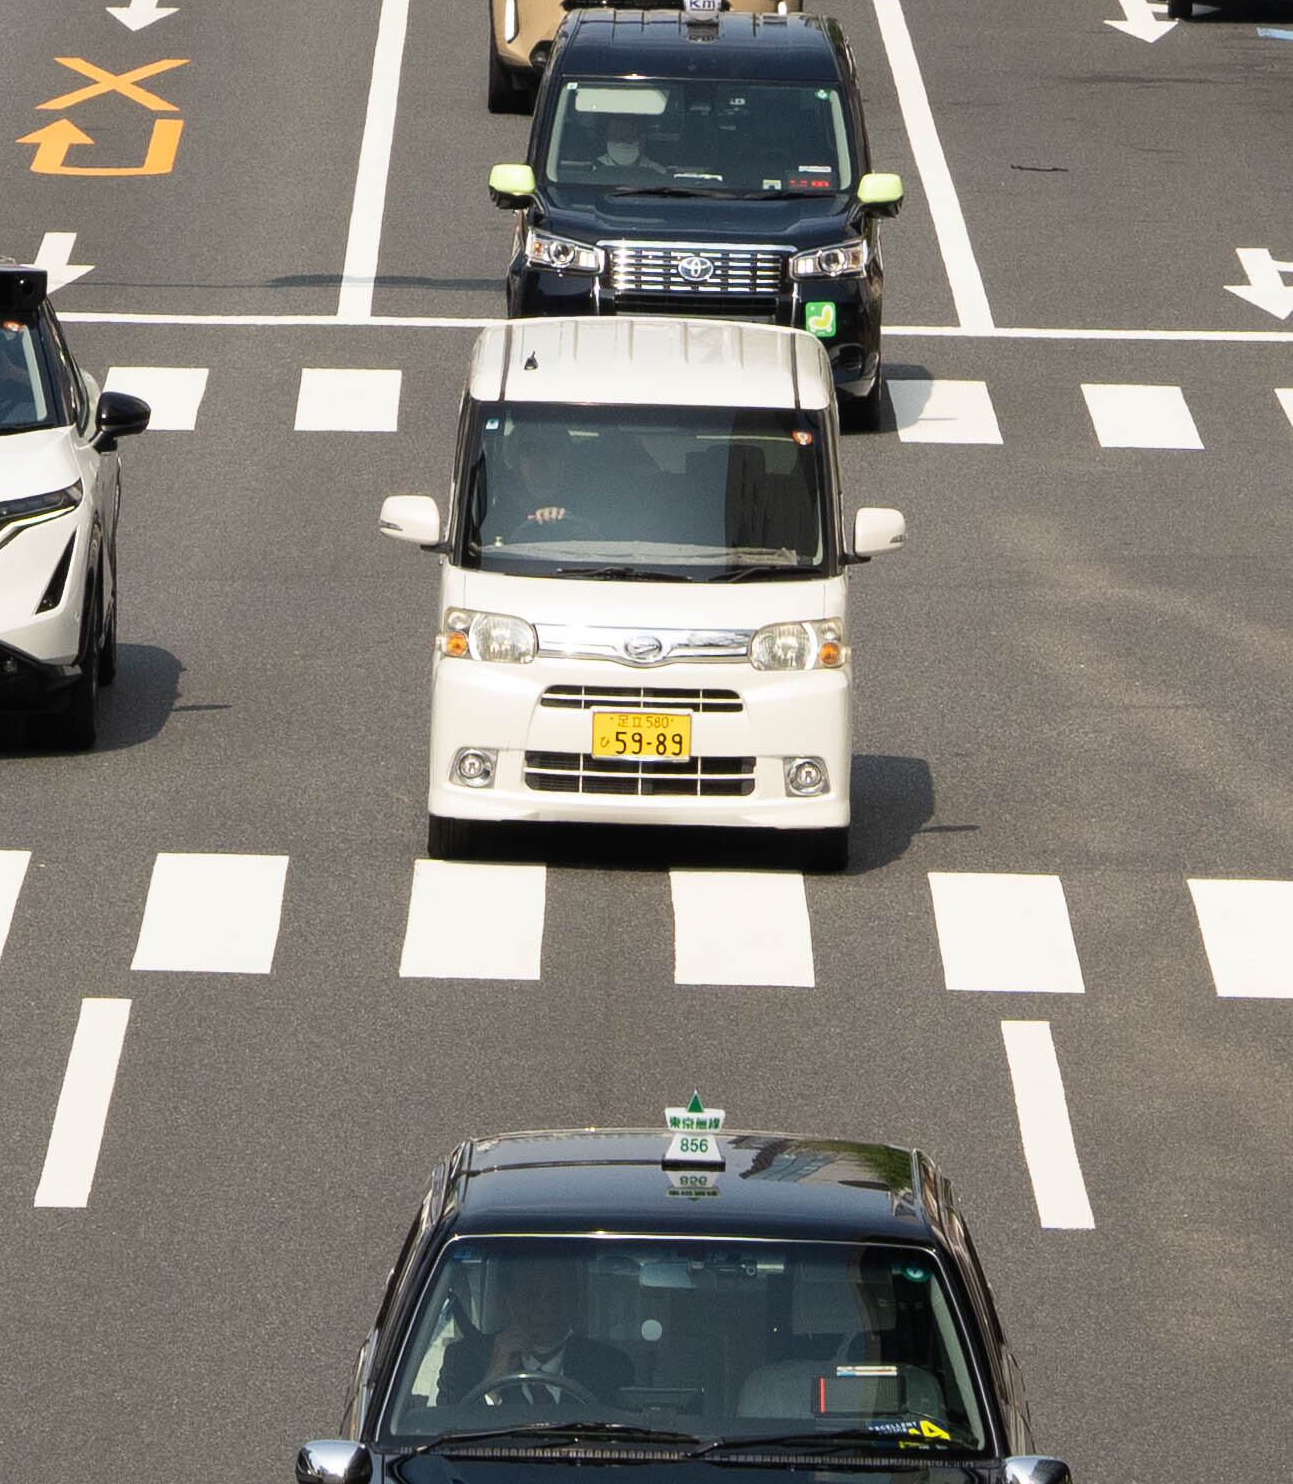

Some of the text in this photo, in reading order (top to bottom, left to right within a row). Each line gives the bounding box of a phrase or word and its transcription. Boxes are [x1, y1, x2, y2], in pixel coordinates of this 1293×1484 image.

[617, 715, 670, 729] 足立580
[615, 731, 683, 757] 59-89
[669, 1118, 720, 1131] 東京無線
[679, 1137, 709, 1153] 856
